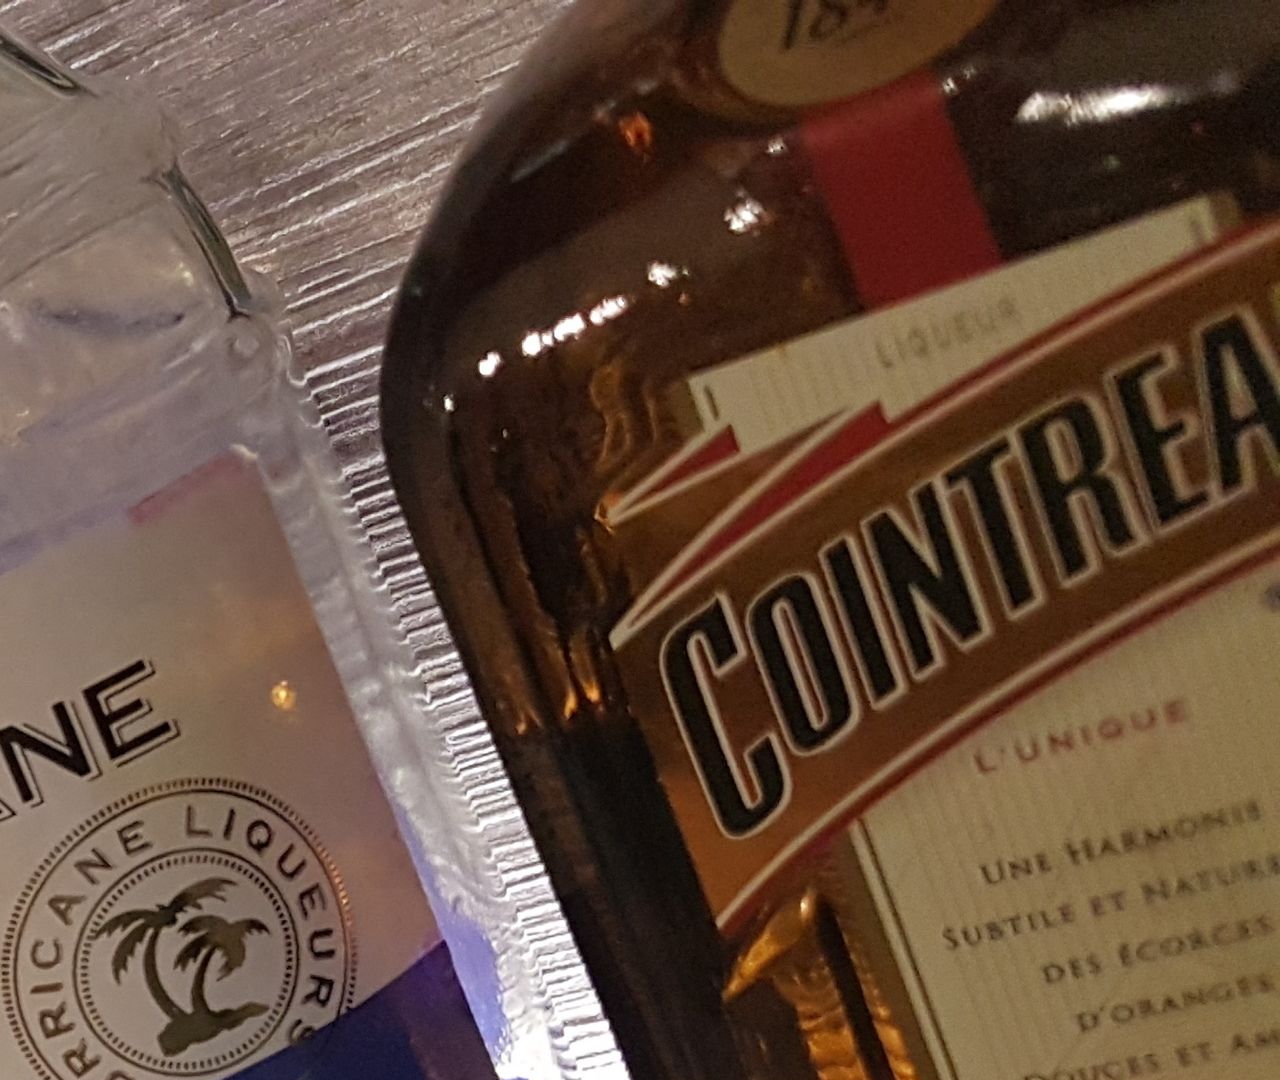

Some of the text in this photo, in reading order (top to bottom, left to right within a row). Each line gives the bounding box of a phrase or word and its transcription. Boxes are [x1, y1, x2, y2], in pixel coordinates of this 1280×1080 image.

[872, 294, 1020, 370] LIQUEUR
[659, 308, 1280, 840] COINTREA
[972, 700, 1188, 776] L'UNIQUE
[980, 800, 1263, 887] UNE HARMONIE
[941, 902, 1077, 952] SUBTILE
[1089, 889, 1129, 919] ET
[1042, 952, 1104, 986] DES
[1173, 1041, 1215, 1070] ET
